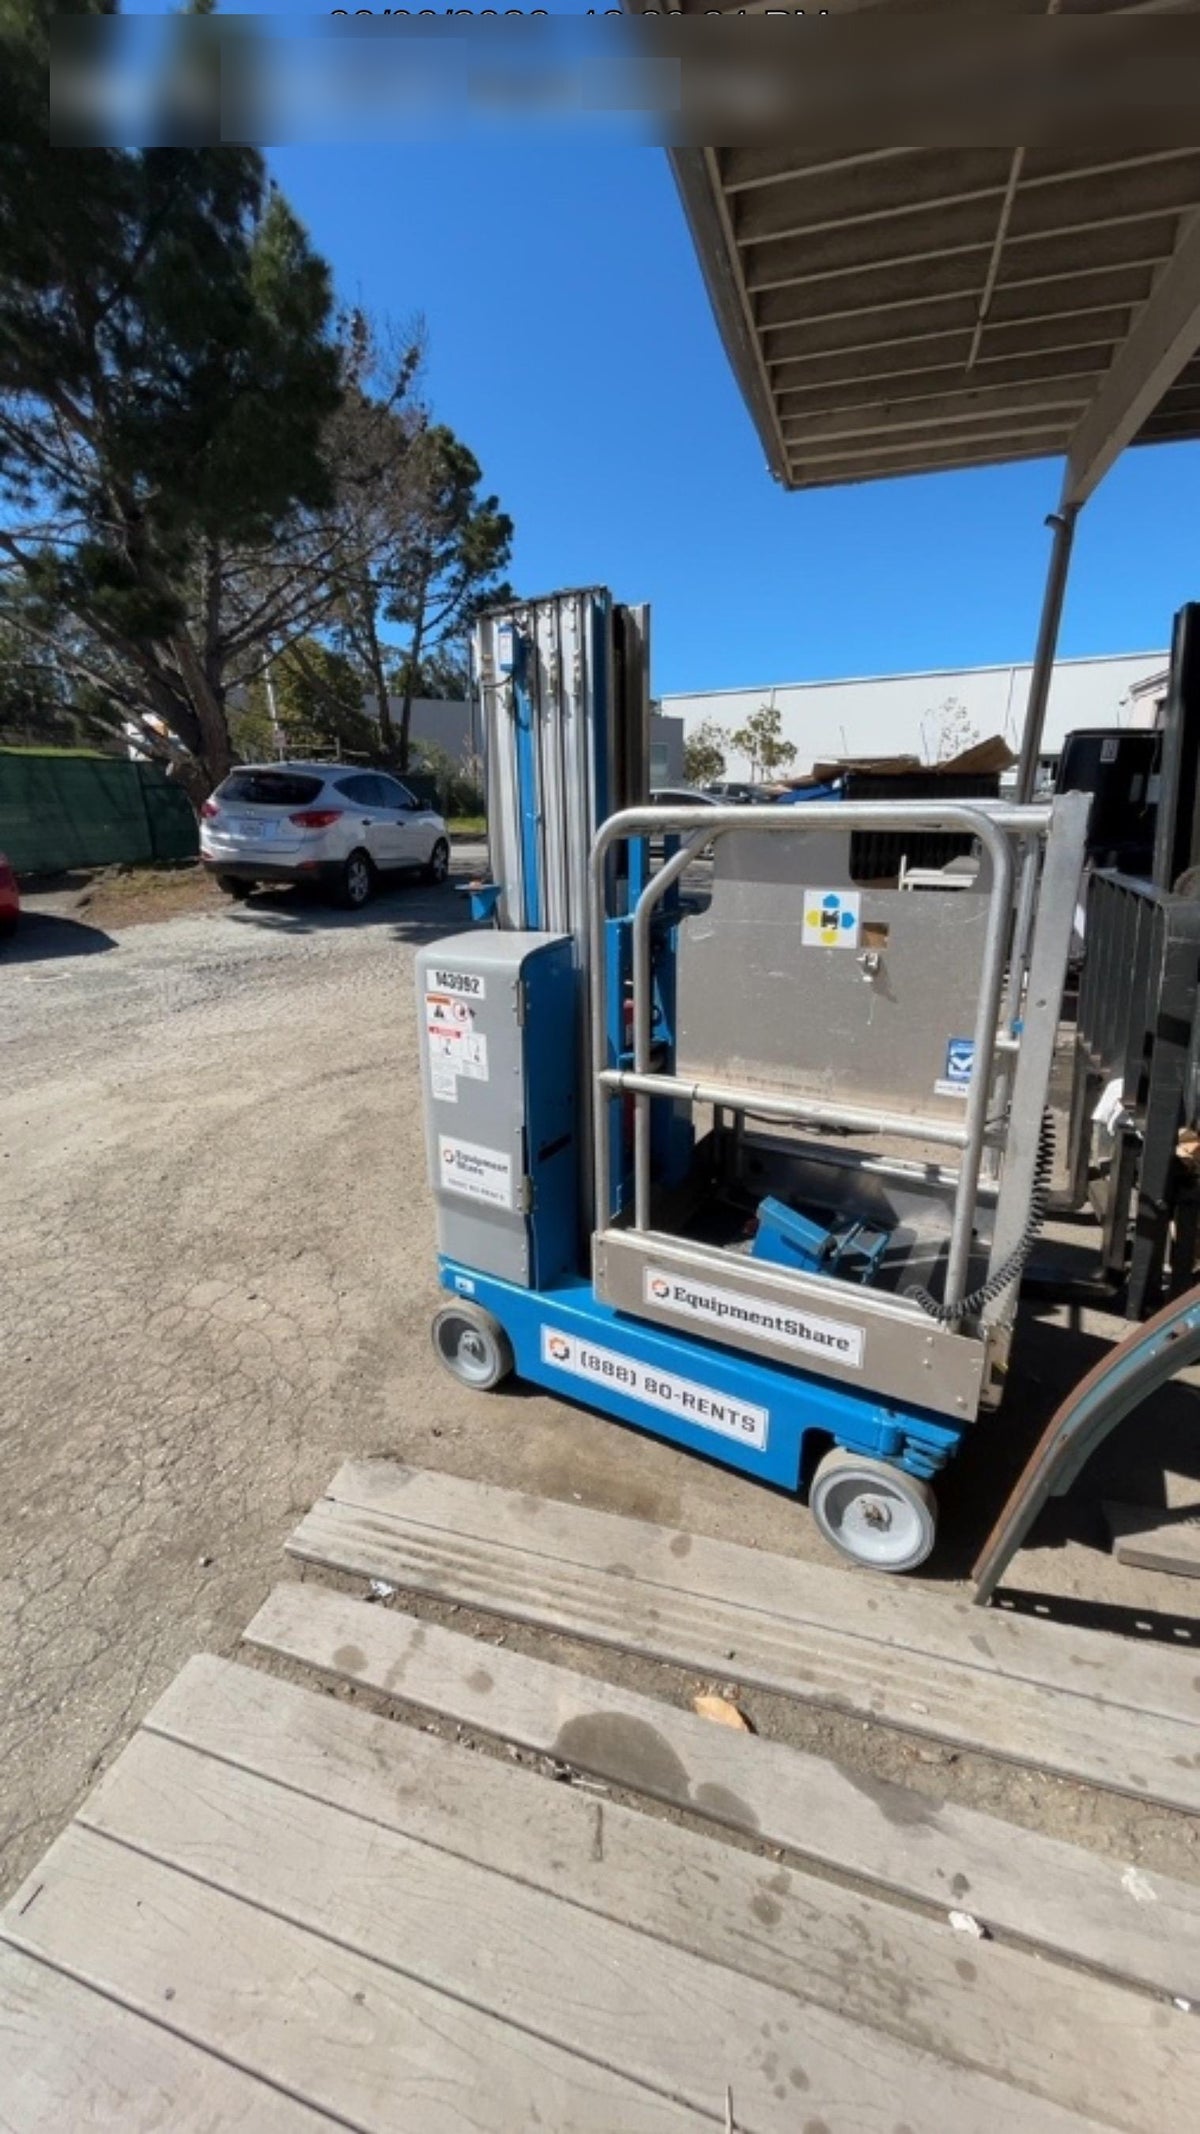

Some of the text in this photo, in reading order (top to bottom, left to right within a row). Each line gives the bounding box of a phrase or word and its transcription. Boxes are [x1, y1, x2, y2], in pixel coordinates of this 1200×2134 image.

[673, 1286, 850, 1351] EquipmentShare
[580, 1351, 756, 1433] (888) 80-RENTS
